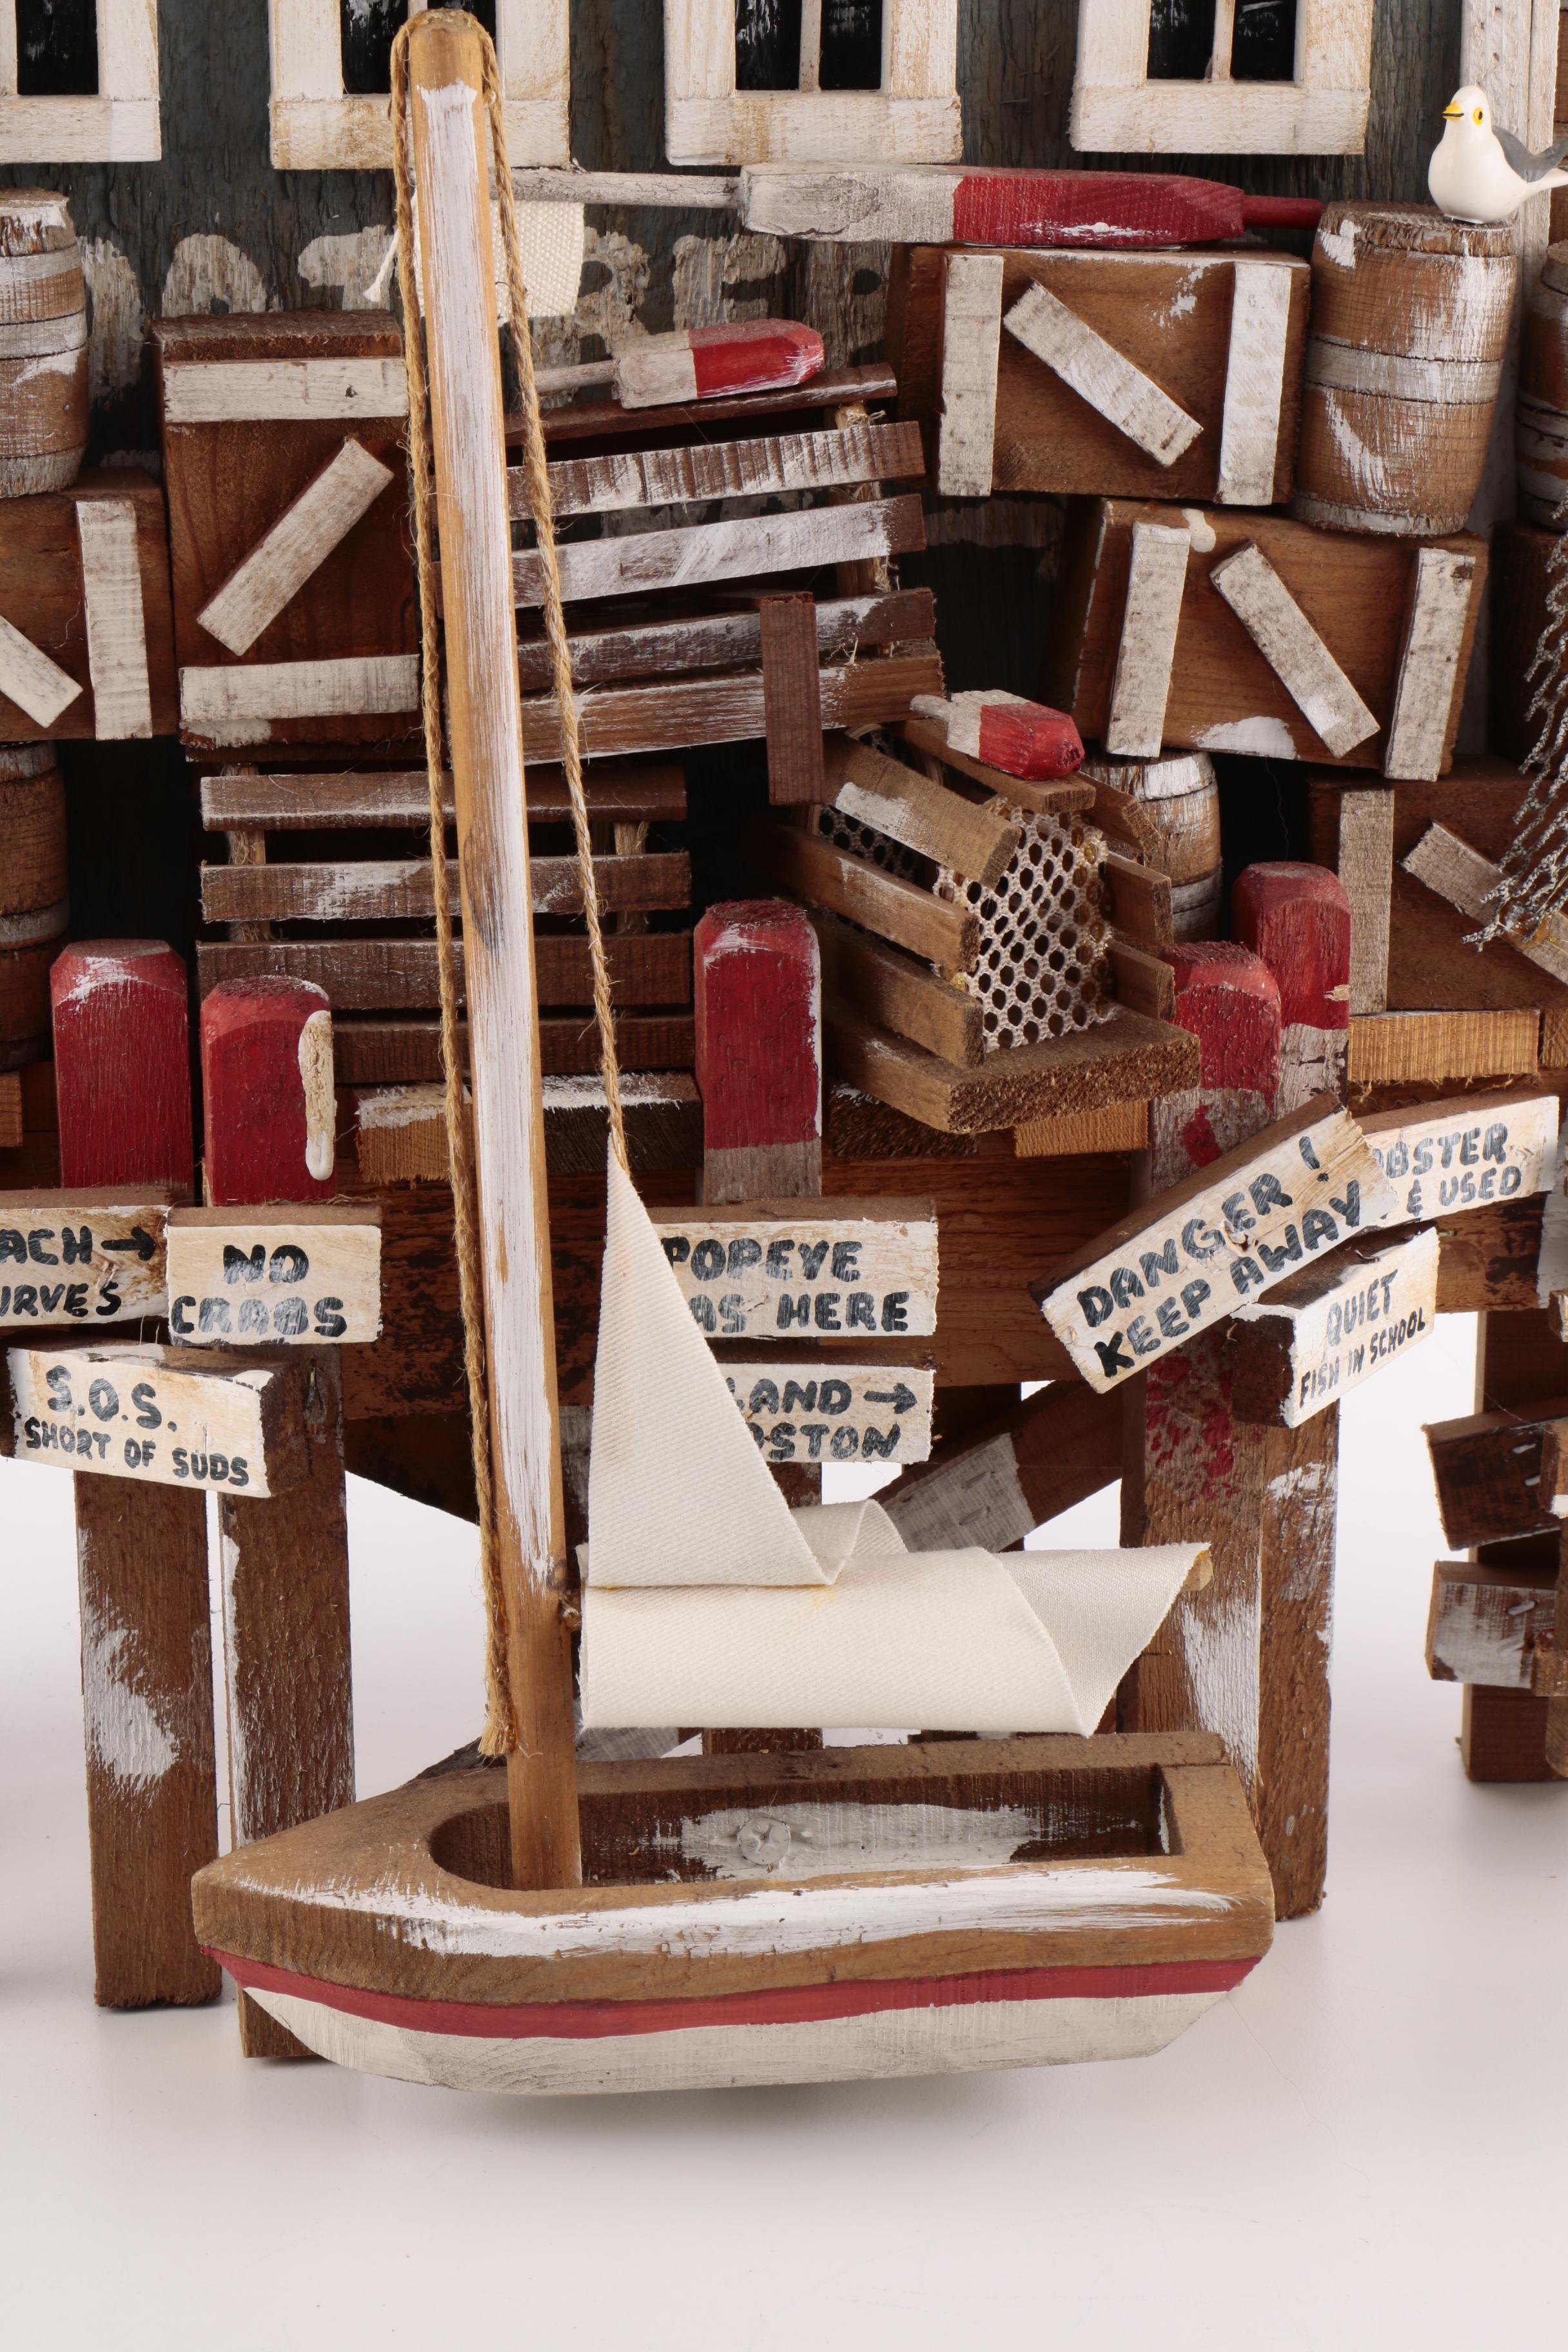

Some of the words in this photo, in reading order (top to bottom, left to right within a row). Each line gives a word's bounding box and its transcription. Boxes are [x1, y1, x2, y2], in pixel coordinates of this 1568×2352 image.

[1406, 1179, 1424, 1217] &
[1438, 1166, 1522, 1206] USED
[223, 1244, 309, 1285] NO
[660, 1236, 863, 1282] POPEYE
[1094, 1278, 1212, 1378] KEEP
[1230, 1180, 1361, 1295] AWAY
[171, 1295, 348, 1337] CRABS
[776, 1291, 910, 1331] HERE
[1327, 1268, 1398, 1347] QUIET
[1348, 1344, 1364, 1377] IN
[1370, 1306, 1426, 1365] SCHOOL
[46, 1364, 177, 1432] S.O.S.
[24, 1416, 111, 1460] SHORT
[124, 1438, 156, 1469] OF
[172, 1447, 250, 1487] SUDS
